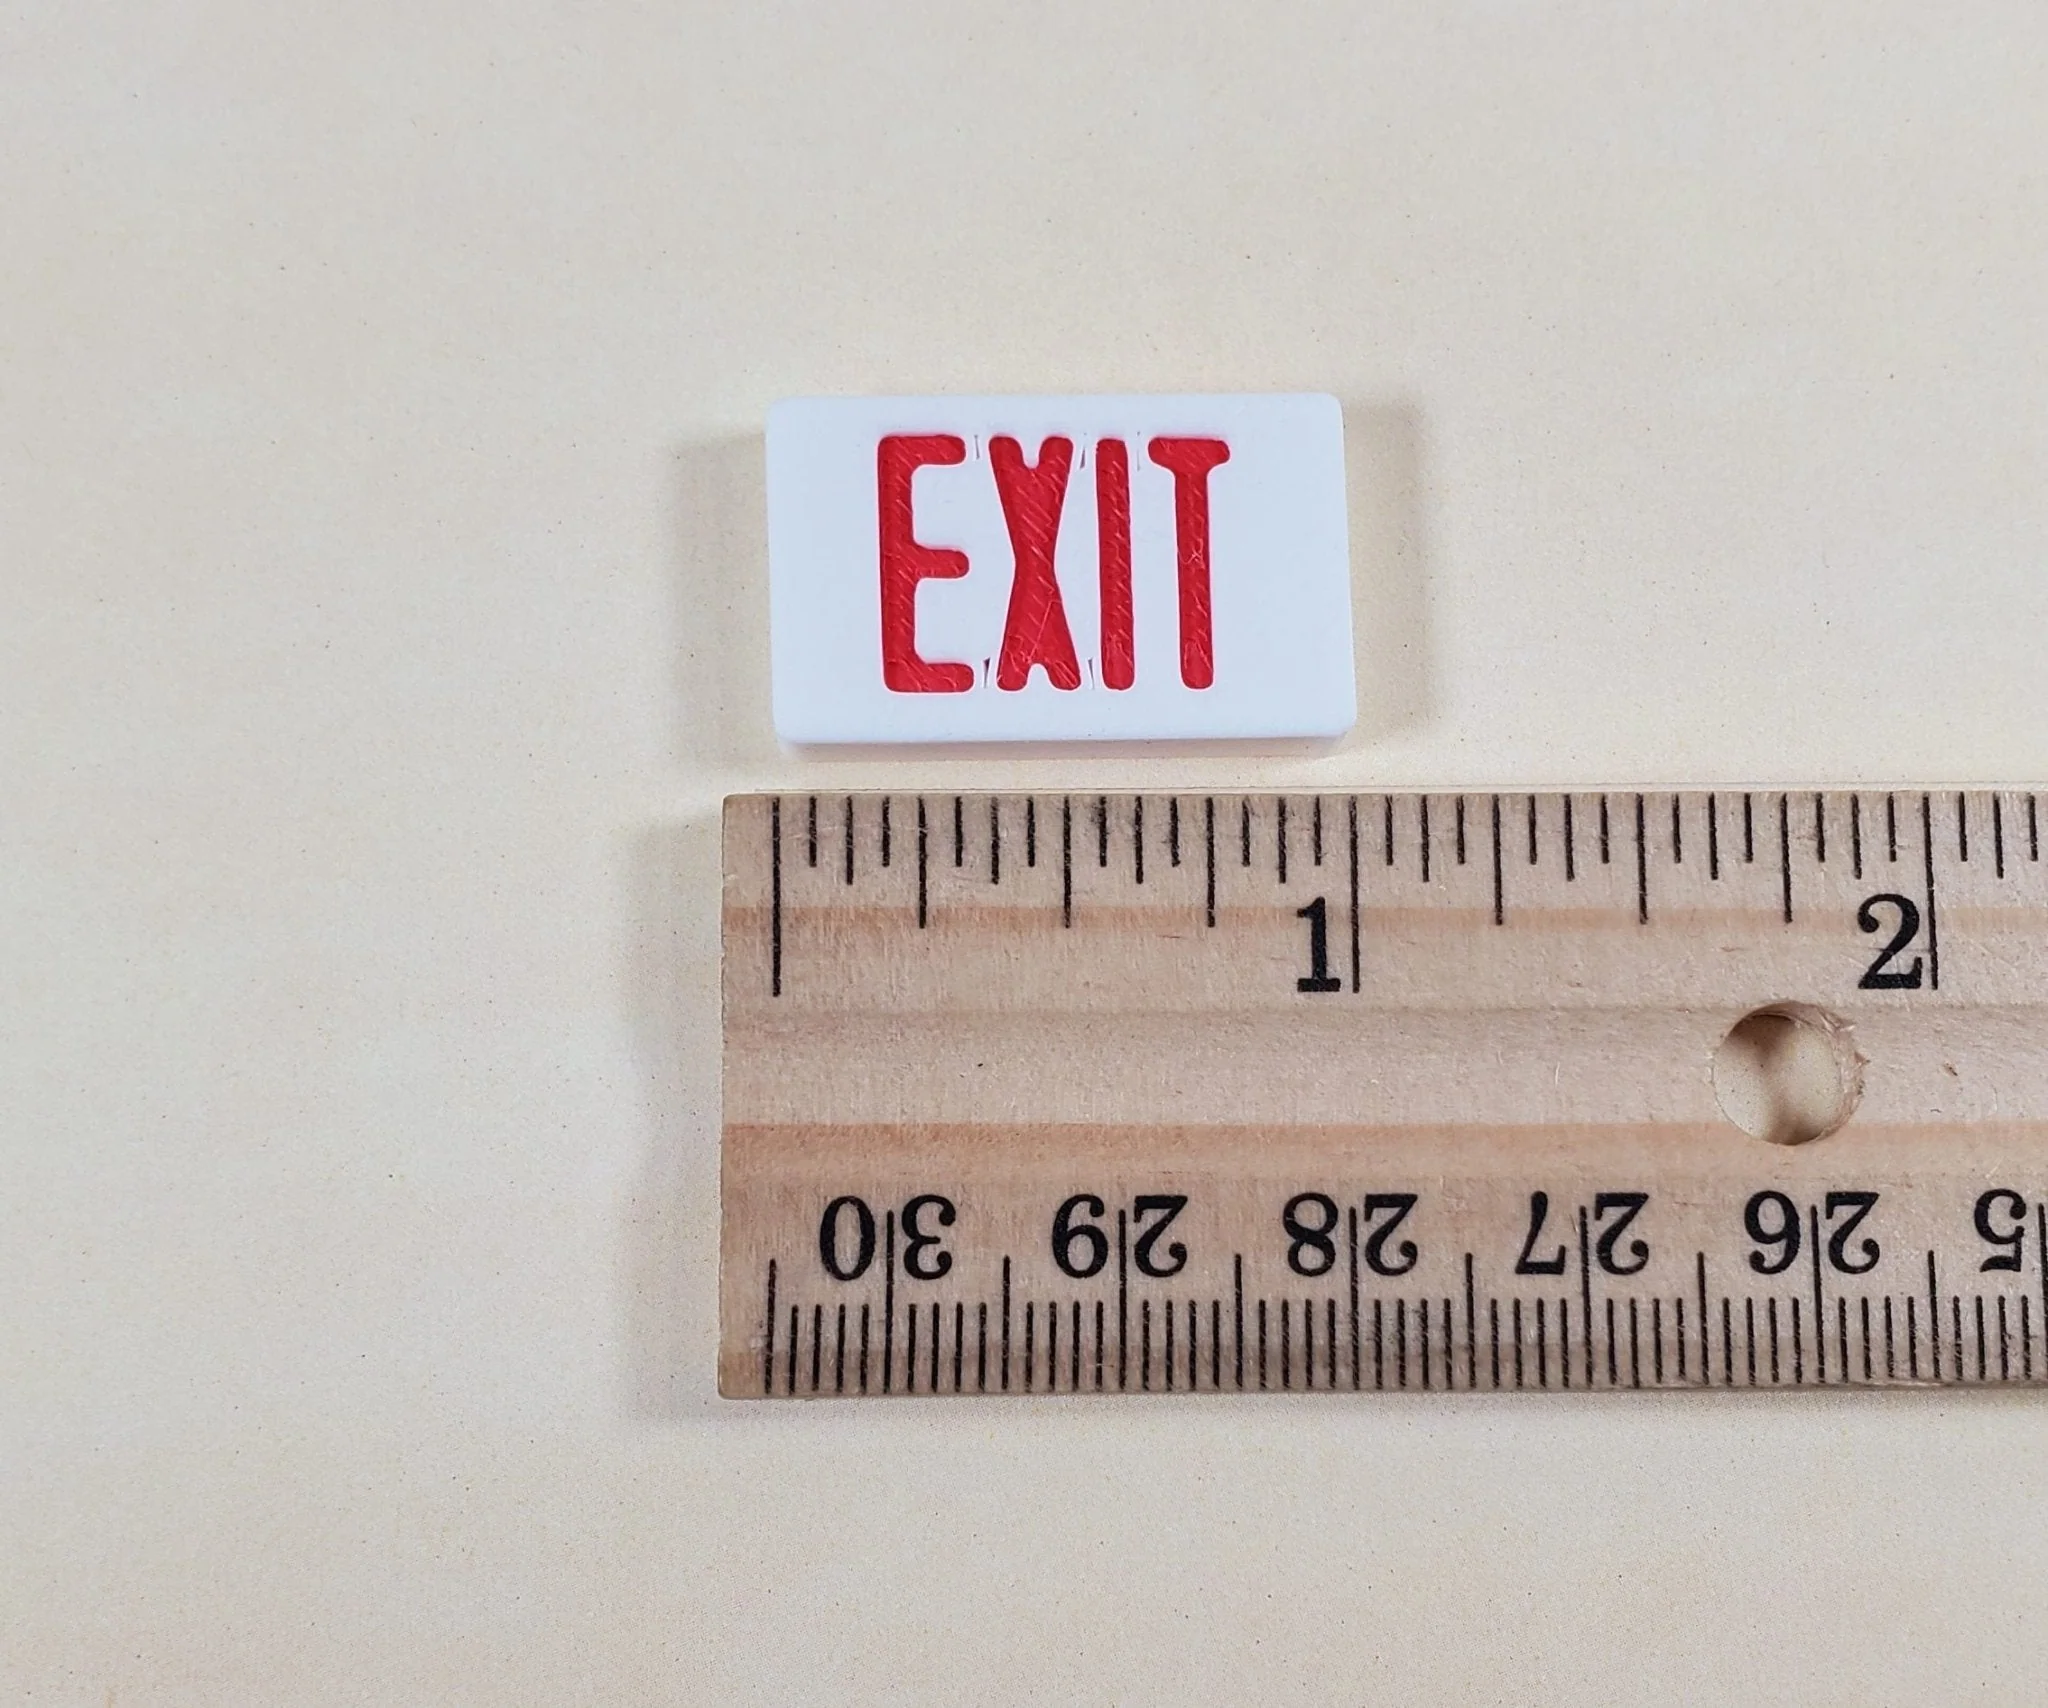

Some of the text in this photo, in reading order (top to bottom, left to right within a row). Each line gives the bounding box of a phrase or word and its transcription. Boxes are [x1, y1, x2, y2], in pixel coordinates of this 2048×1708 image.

[876, 433, 1231, 693] EXIT
[1297, 897, 1342, 993] 1
[1857, 894, 1923, 990] 2
[819, 1194, 957, 1282] 30
[1052, 1193, 1189, 1280] 29
[1283, 1192, 1419, 1278] 28
[1515, 1191, 1650, 1276] 27
[1744, 1190, 1881, 1276] 26
[1974, 1188, 2027, 1273] 5
